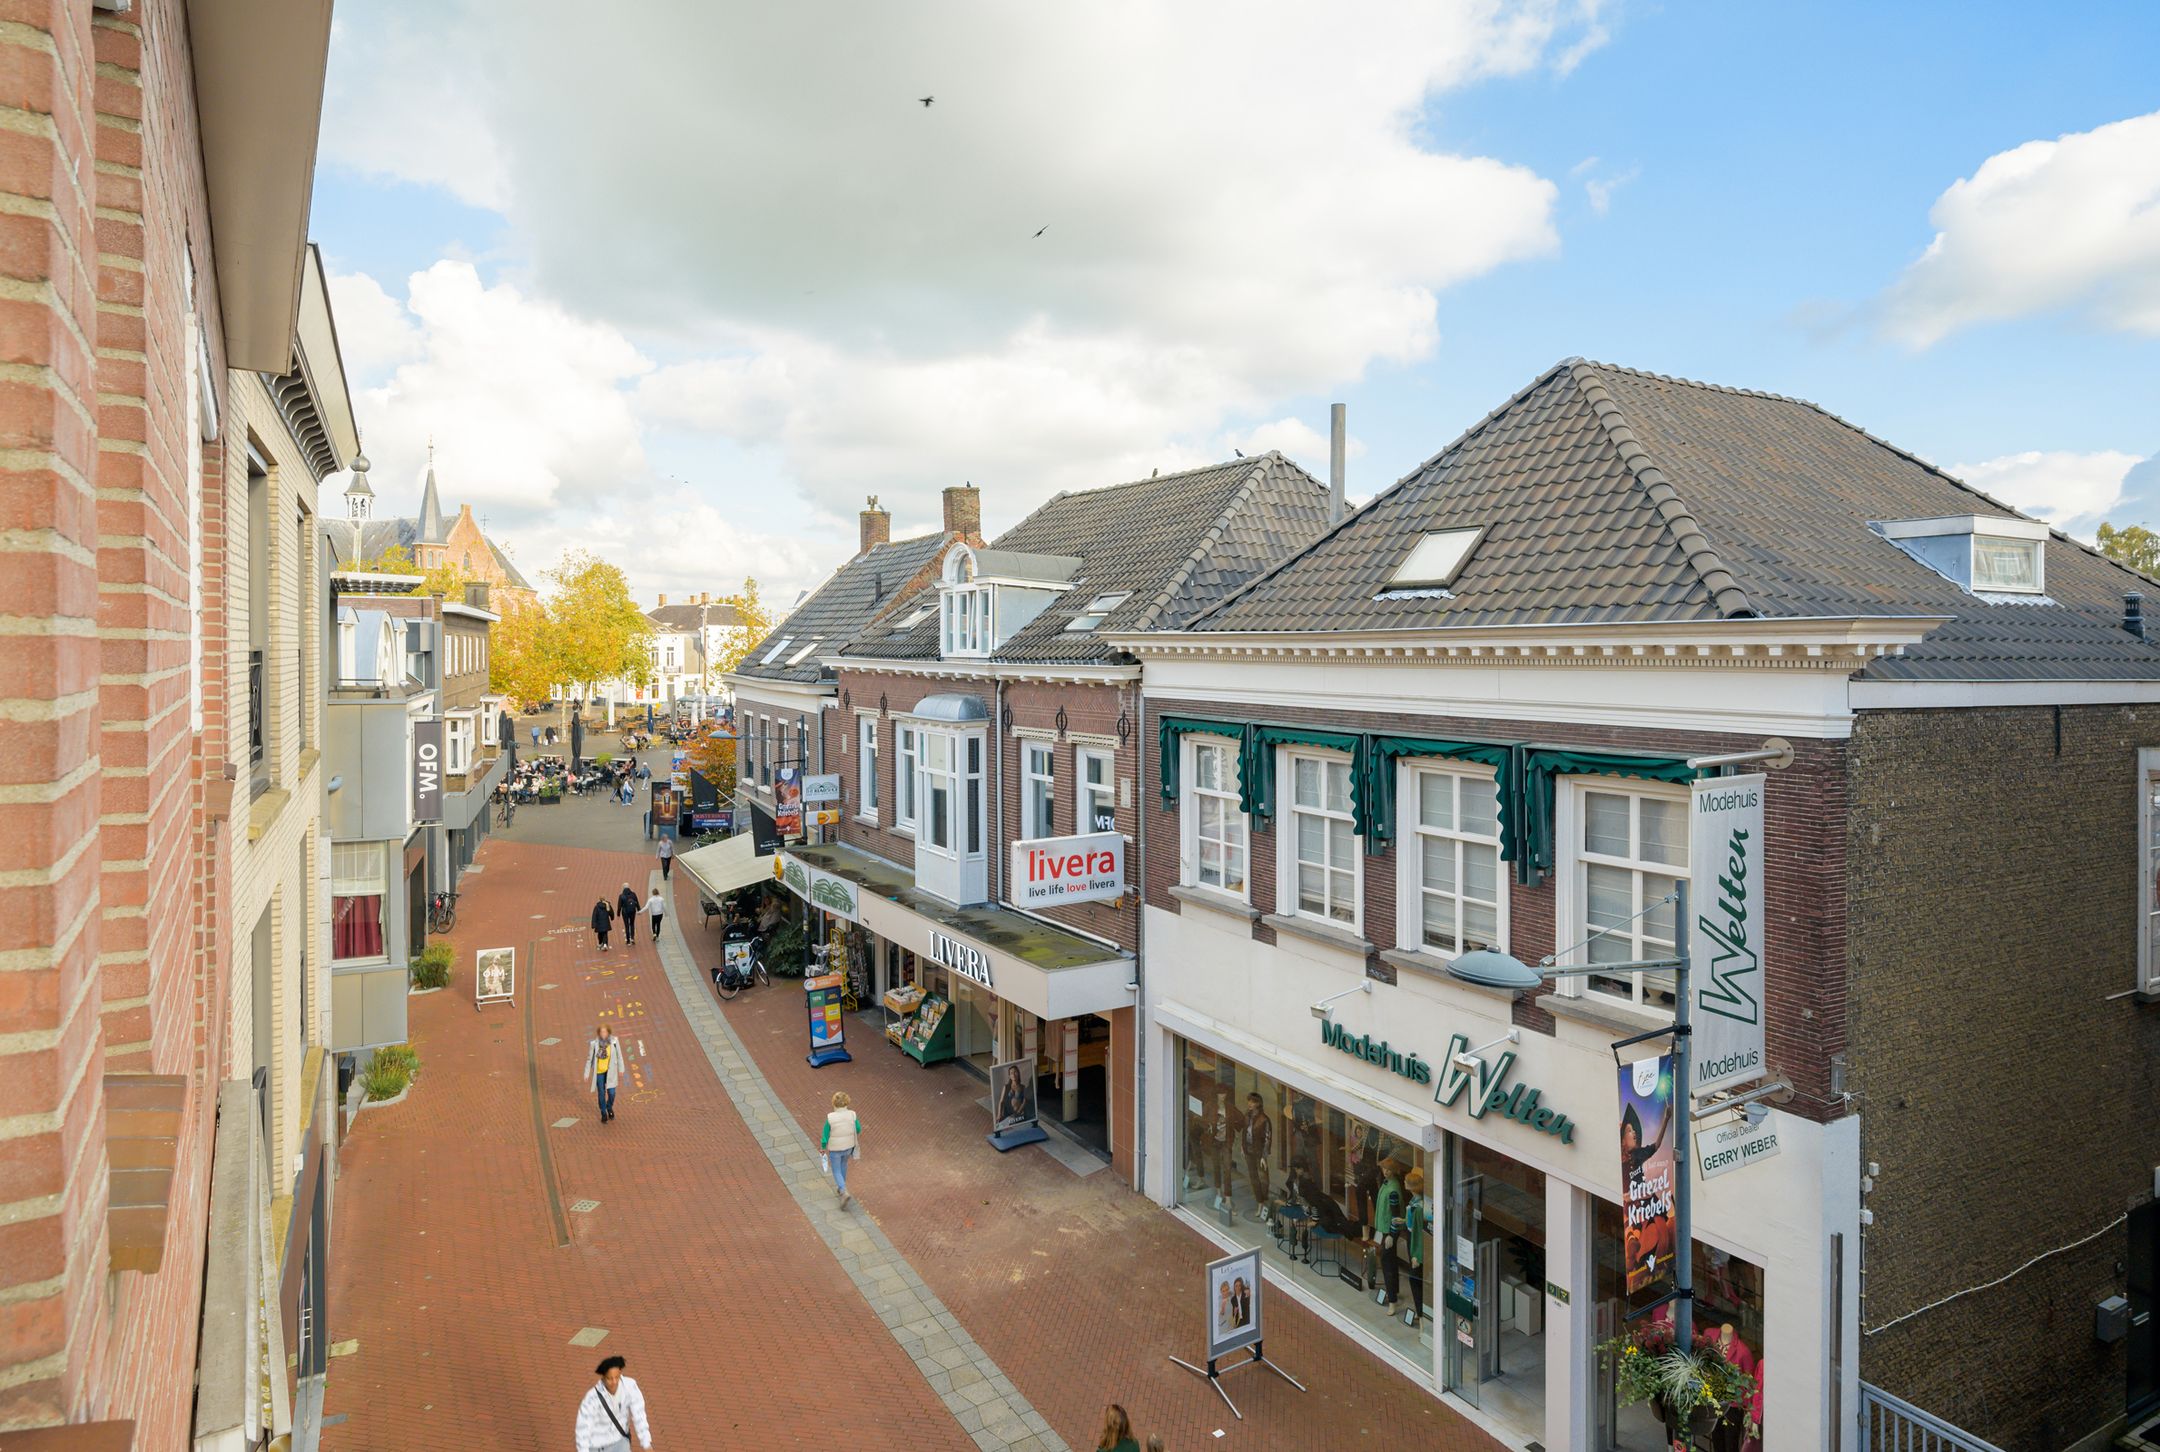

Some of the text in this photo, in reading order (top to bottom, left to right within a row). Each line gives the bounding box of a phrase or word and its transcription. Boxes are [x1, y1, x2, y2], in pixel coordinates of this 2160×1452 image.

[418, 743, 438, 799] OFM.
[1699, 788, 1758, 813] Modehuis
[1029, 850, 1115, 882] livera
[1029, 879, 1115, 898] live life love livera
[1699, 828, 1757, 1025] Welten
[928, 929, 993, 989] LIVERA
[1321, 1018, 1575, 1145] Modehuis Welten
[1699, 1048, 1759, 1082] Modehuis
[1703, 1134, 1778, 1171] GERRY WEBER
[1716, 1128, 1739, 1143] Official
[1629, 1167, 1670, 1202] Griezel
[1628, 1190, 1672, 1227] Kriebels
